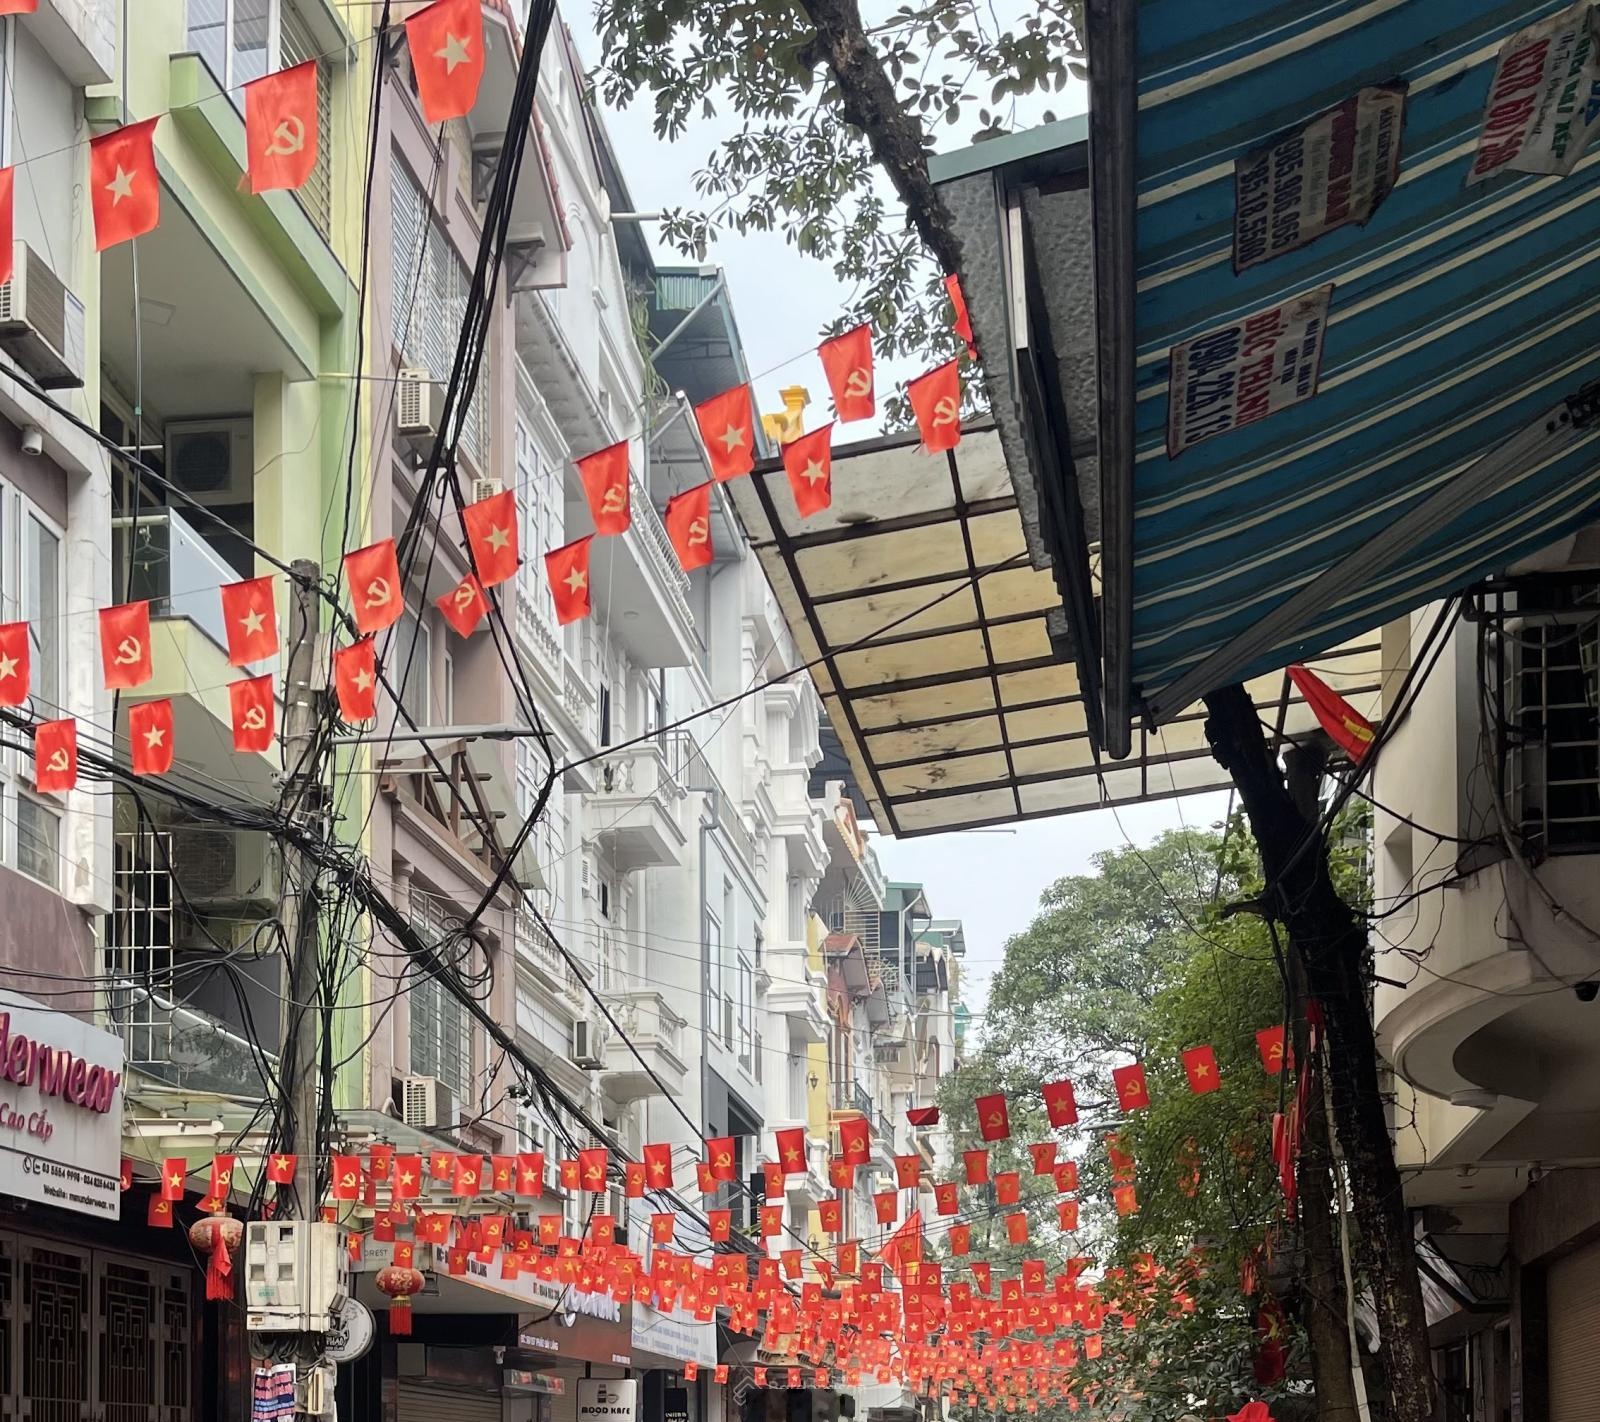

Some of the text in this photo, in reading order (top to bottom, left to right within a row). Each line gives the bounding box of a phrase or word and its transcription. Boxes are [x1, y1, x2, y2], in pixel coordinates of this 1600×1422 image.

[1235, 308, 1288, 425] ĐỨC THÀNH
[1185, 326, 1240, 443] 0984.226.113
[0, 1103, 53, 1143] Cao Cấp
[42, 1163, 50, 1174] 03
[43, 1184, 68, 1199] Website:
[581, 1406, 608, 1414] MOOD
